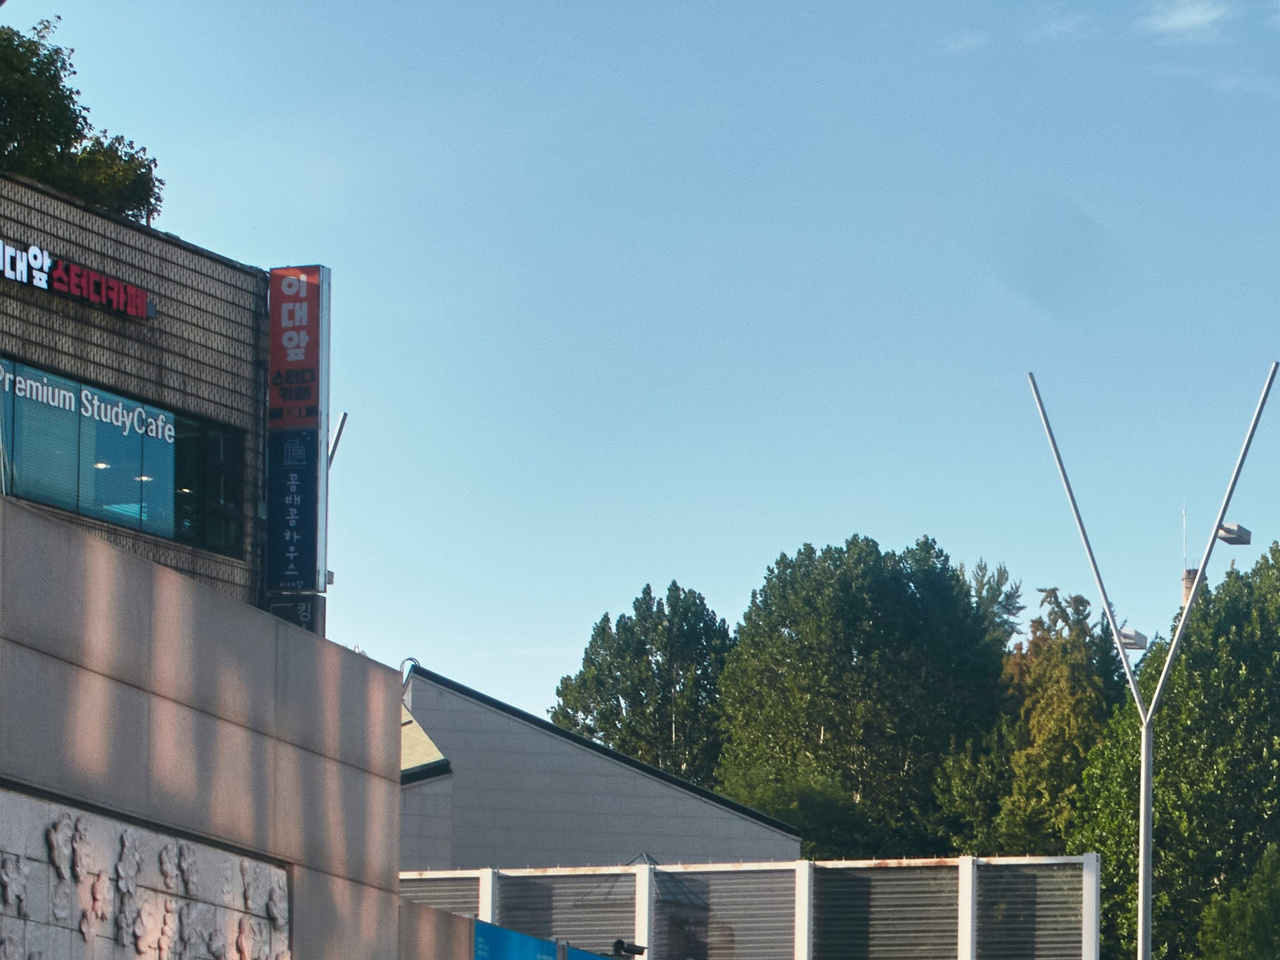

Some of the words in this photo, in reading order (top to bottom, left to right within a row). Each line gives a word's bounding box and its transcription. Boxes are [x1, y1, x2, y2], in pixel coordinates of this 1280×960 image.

[52, 259, 148, 318] 스터디카페
[281, 274, 310, 362] 이대앞
[81, 389, 175, 443] StudyCafe
